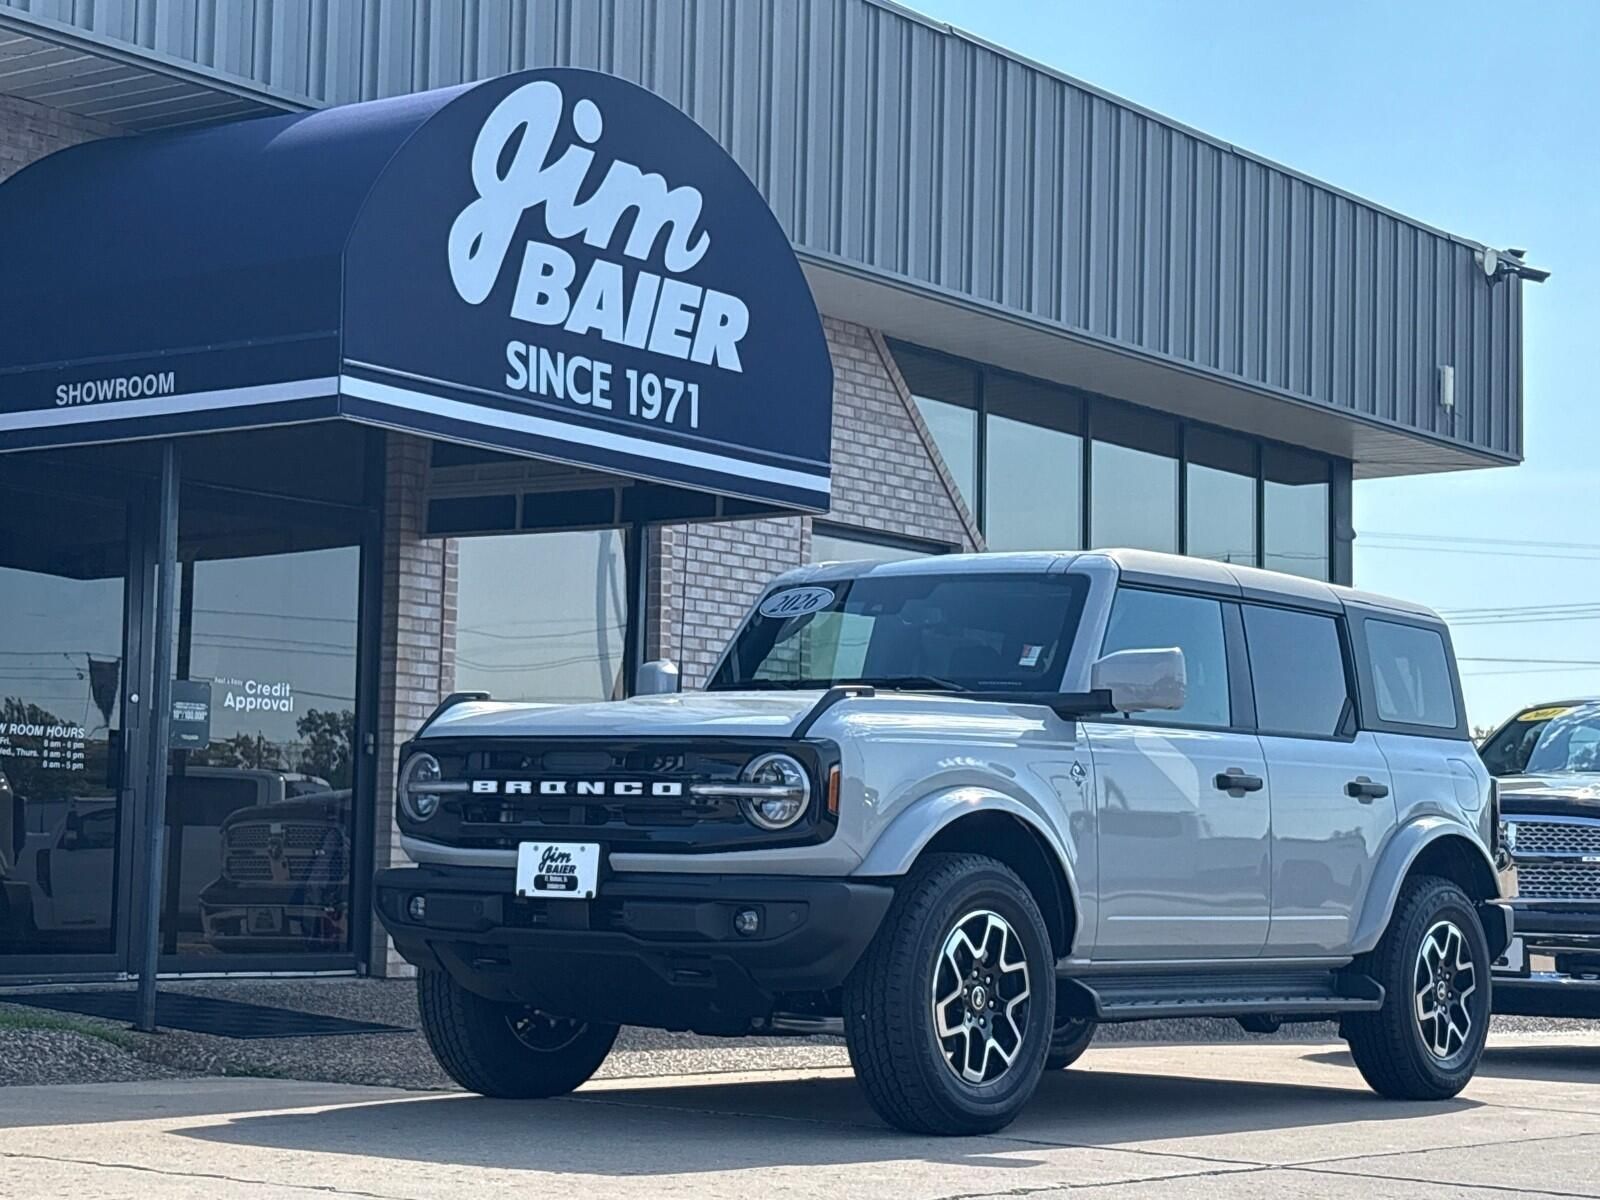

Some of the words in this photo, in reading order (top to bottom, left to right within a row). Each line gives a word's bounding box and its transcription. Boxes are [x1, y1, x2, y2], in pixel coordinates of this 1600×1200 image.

[448, 80, 711, 305] Jim
[510, 239, 750, 373] BAIER
[55, 371, 175, 406] SHOWROOM
[505, 340, 612, 410] SINCE
[625, 368, 699, 429] 1971
[768, 592, 827, 613] 2026
[245, 680, 290, 697] Credit
[223, 691, 294, 713] Approval
[9, 723, 44, 737] ROOM
[46, 725, 86, 739] HOURS
[72, 742, 85, 750] pm
[72, 752, 85, 761] pm
[71, 763, 84, 771] pm
[472, 780, 682, 796] BRONCO
[538, 845, 572, 873] Jim
[545, 864, 577, 874] BAIER
